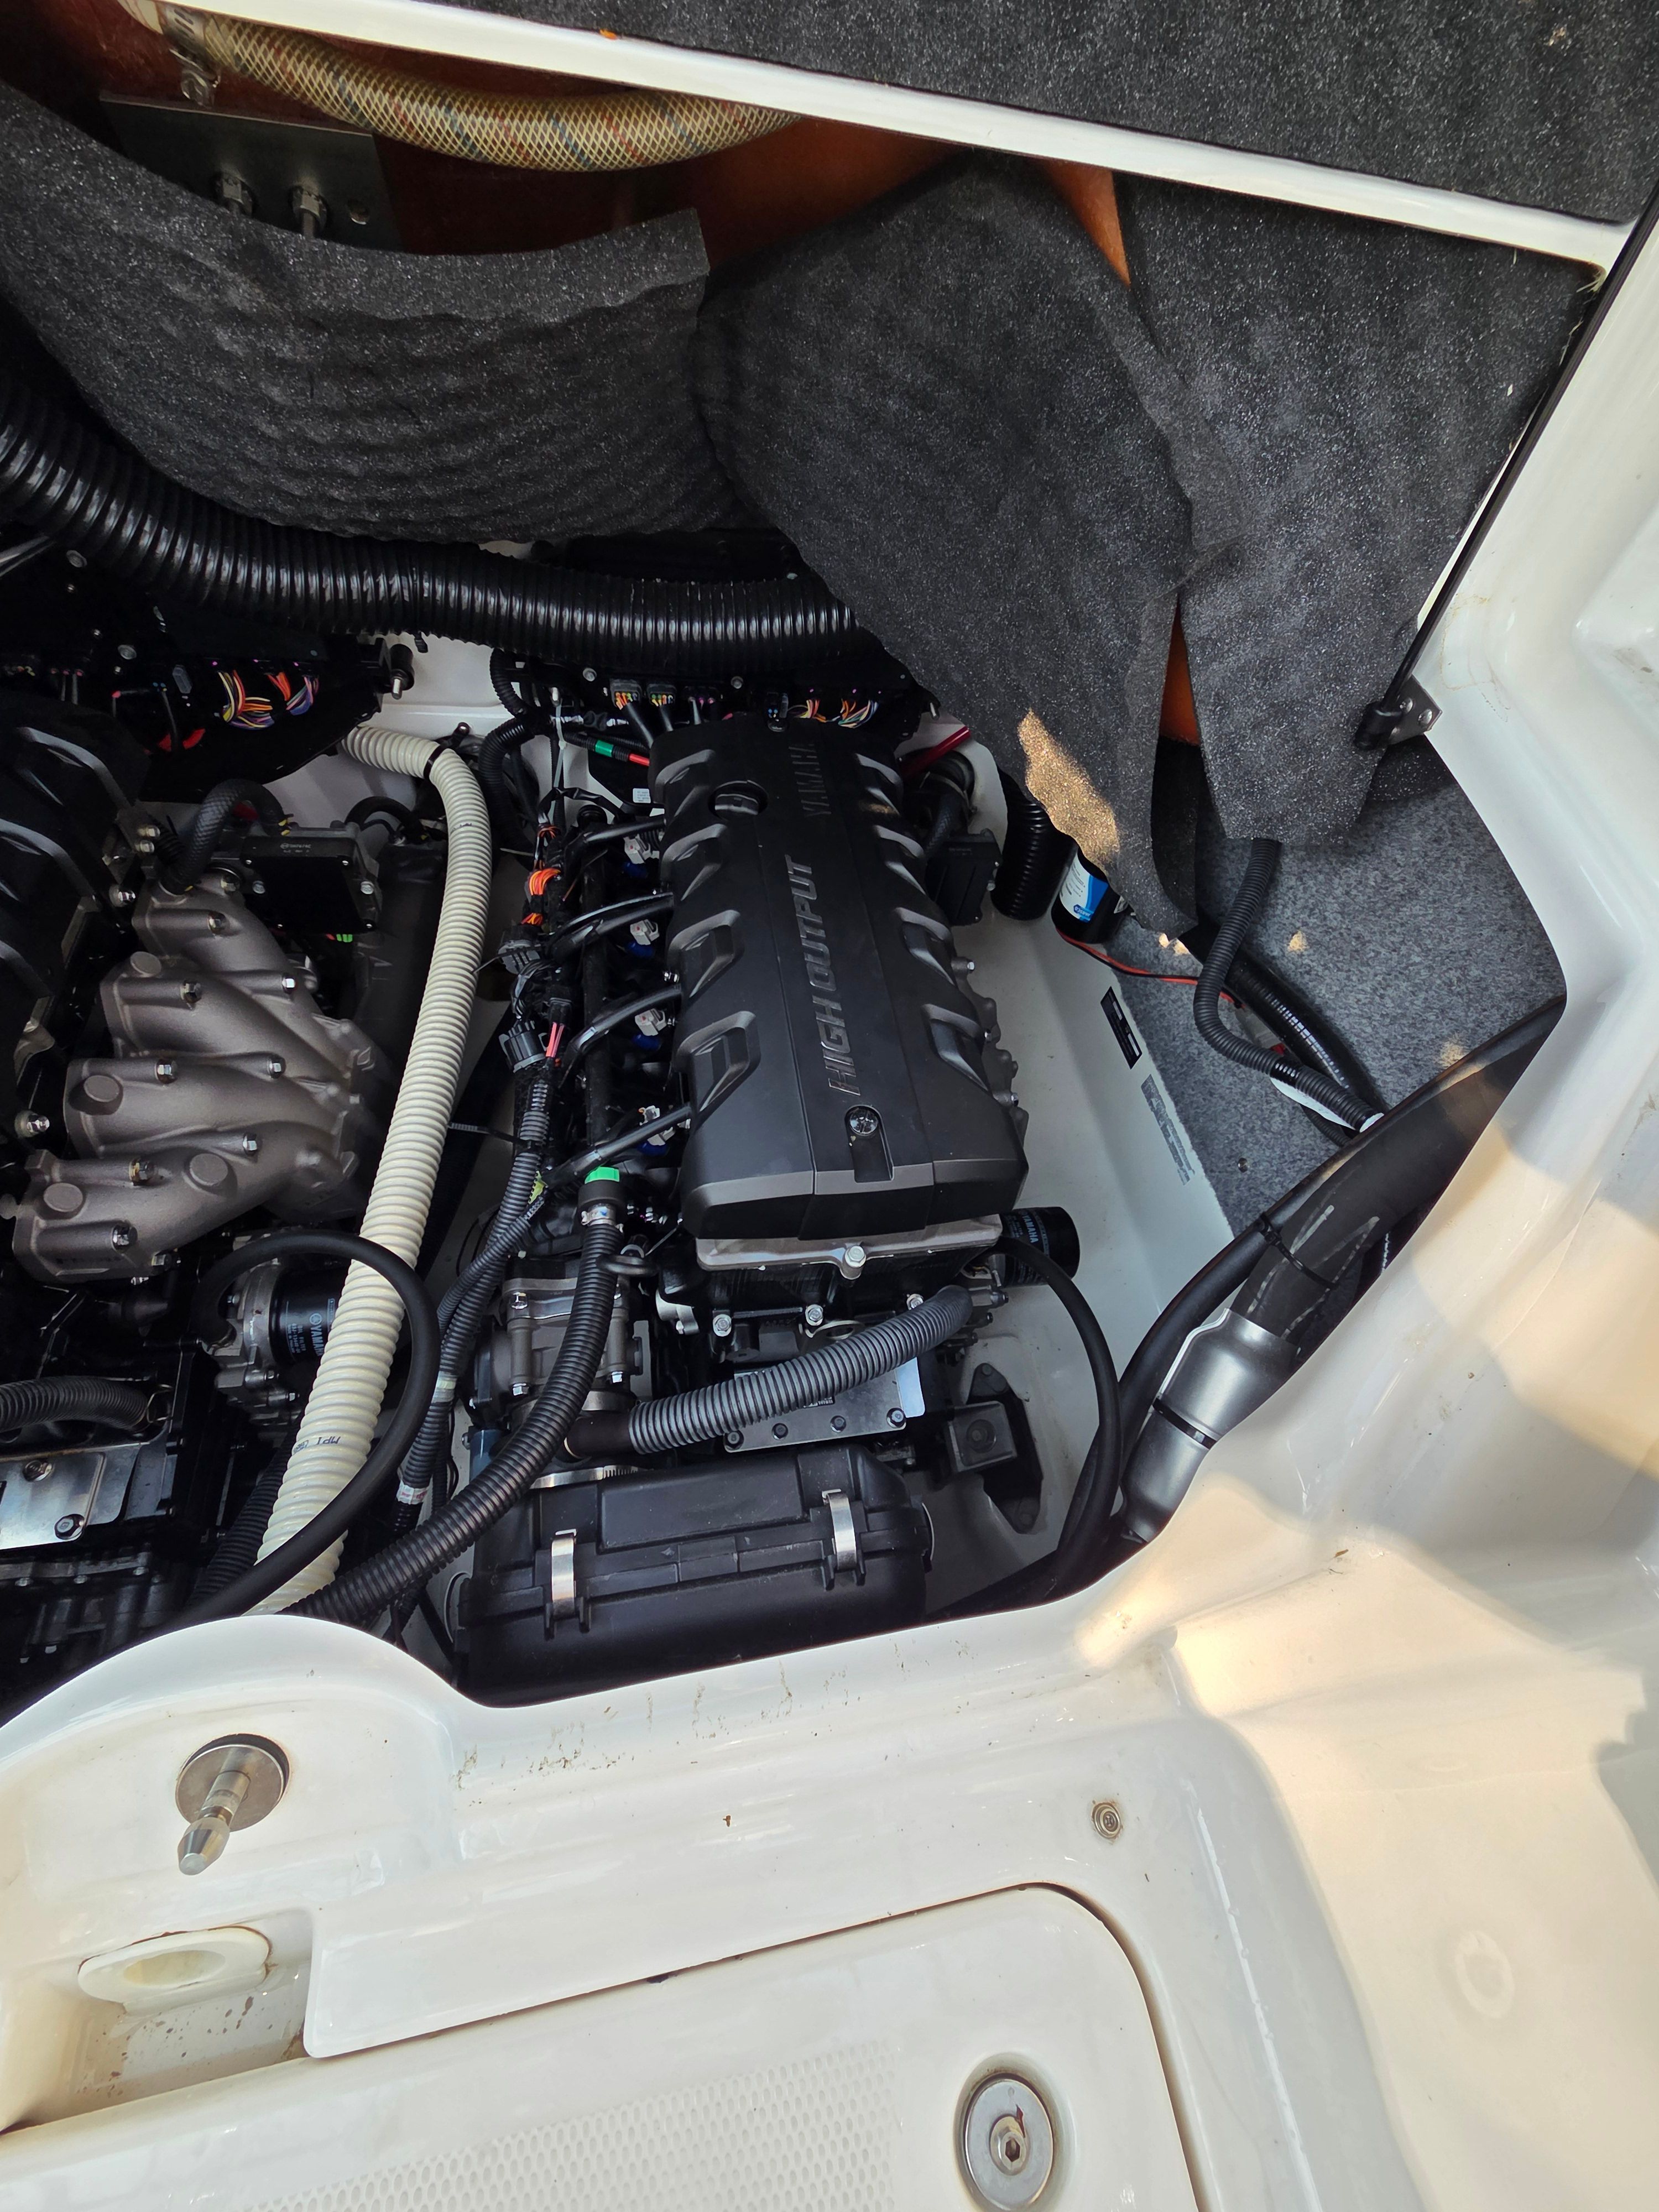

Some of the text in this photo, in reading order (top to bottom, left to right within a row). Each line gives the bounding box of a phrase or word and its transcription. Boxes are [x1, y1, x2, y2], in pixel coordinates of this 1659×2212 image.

[788, 743, 832, 817] YAMAHA
[784, 854, 861, 1096] HIGH OUTPUT
[1022, 1215, 1039, 1243] YAMAHA
[316, 1436, 341, 1445] MPI
